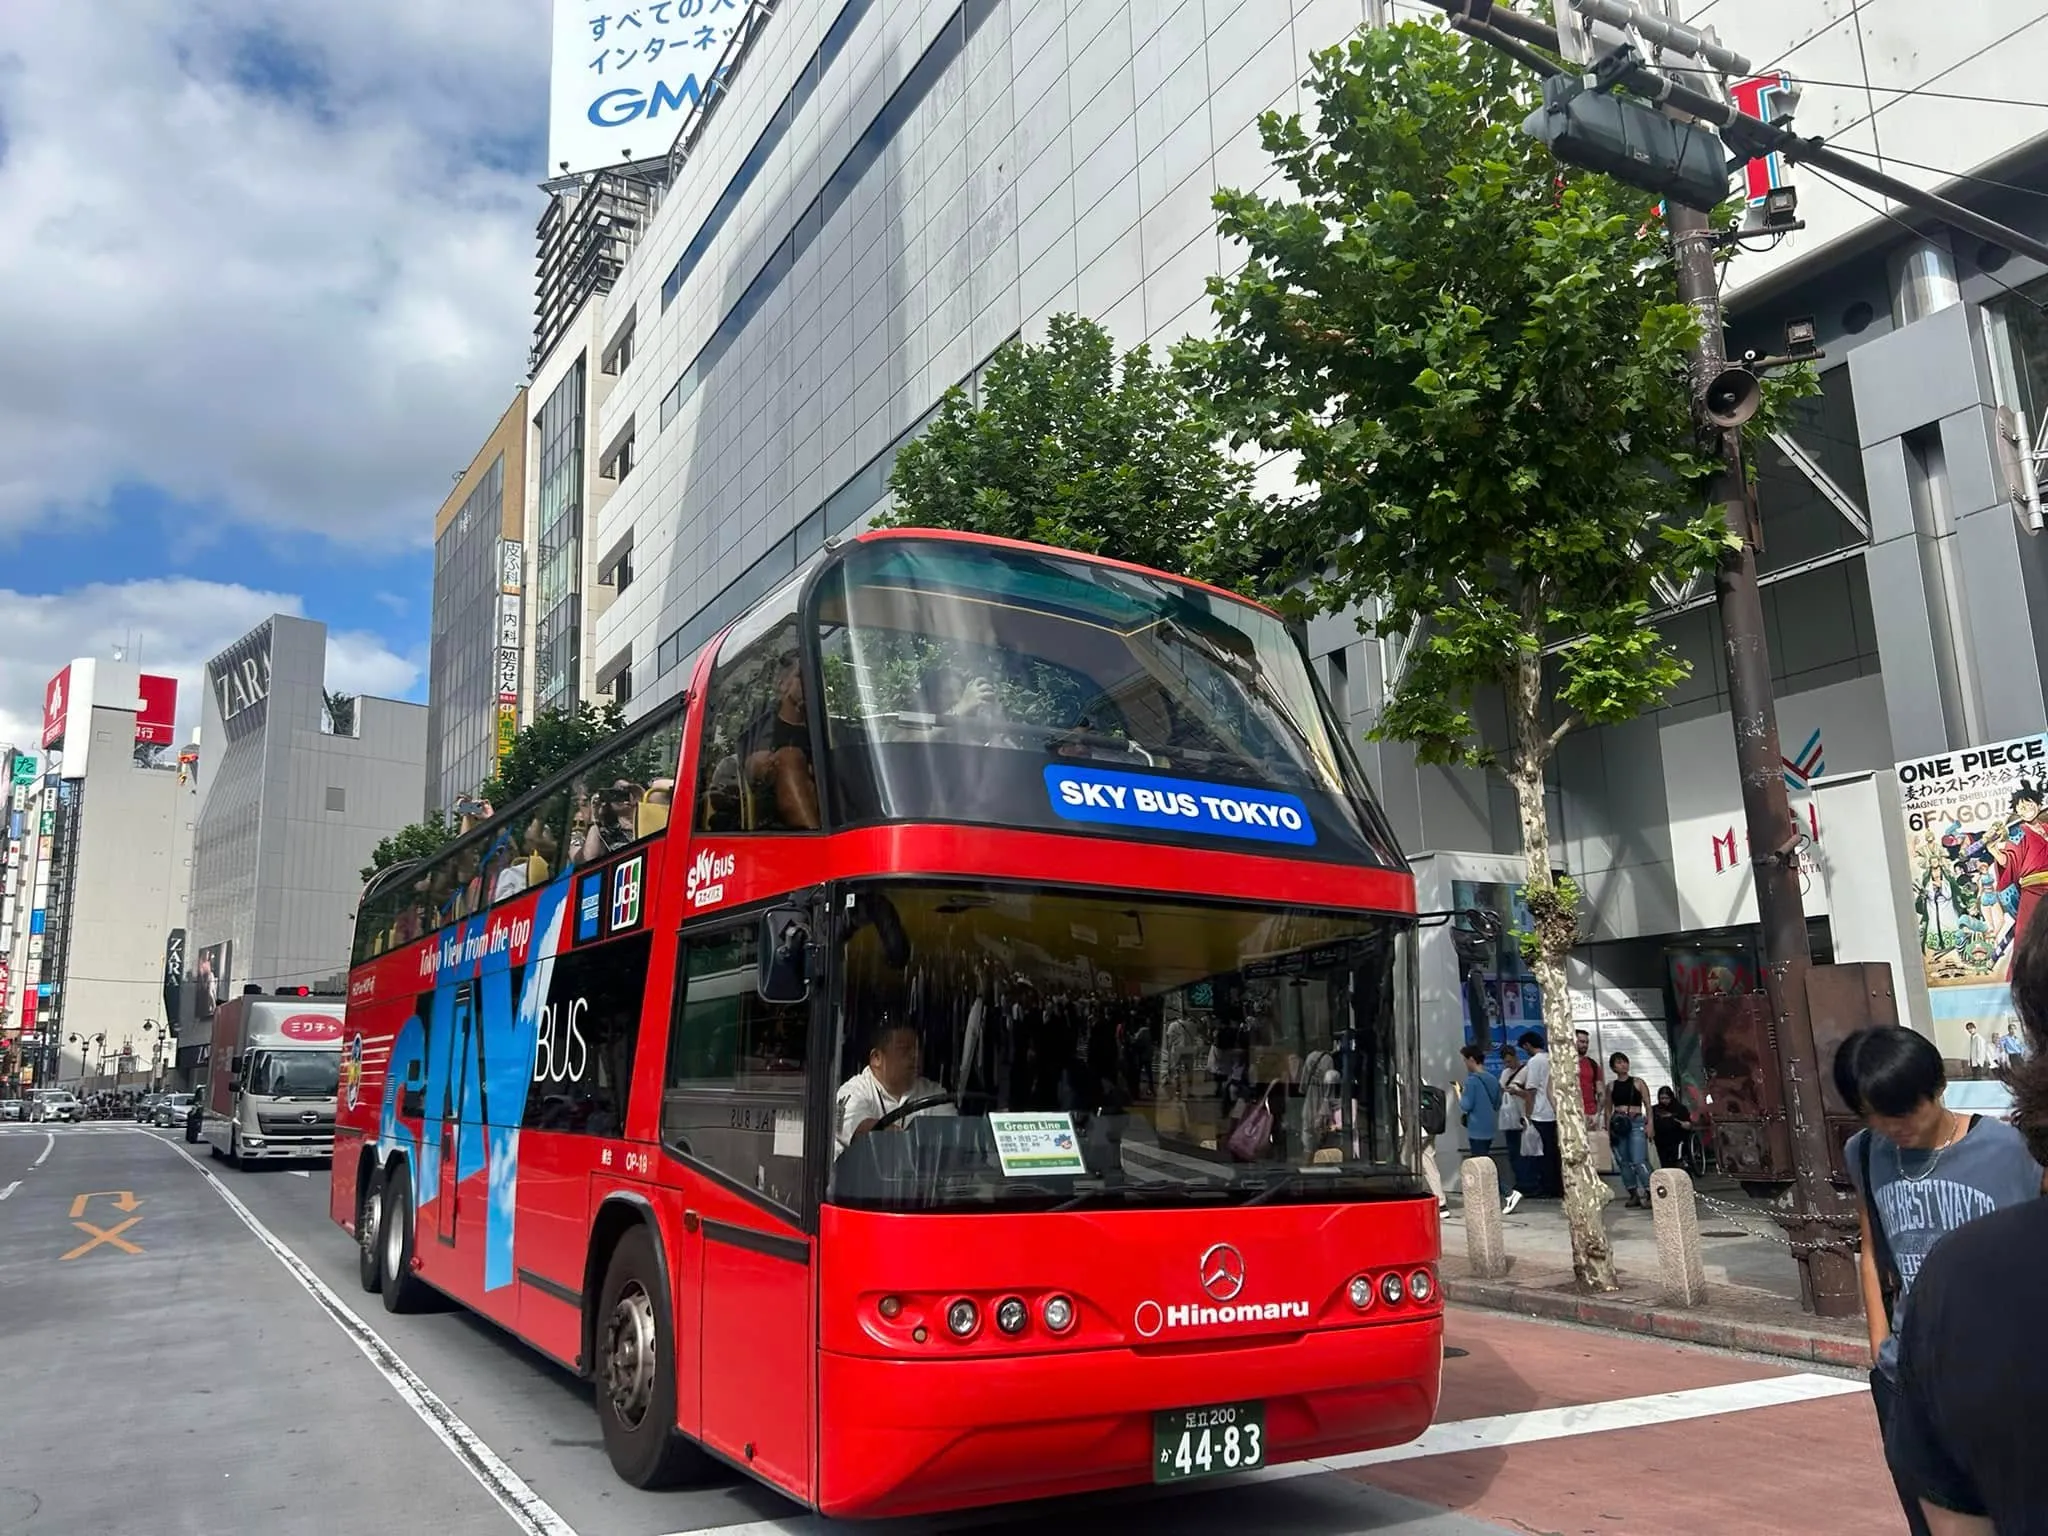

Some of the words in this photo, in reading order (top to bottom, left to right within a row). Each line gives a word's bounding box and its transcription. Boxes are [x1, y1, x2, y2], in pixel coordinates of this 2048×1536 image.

[504, 543, 521, 585] 皮ふ科
[503, 613, 517, 643] 内科
[501, 650, 516, 692] 処方せん
[1899, 757, 1954, 784] ONE
[1961, 739, 2045, 772] PIECE
[1059, 779, 1128, 811] SKY
[1132, 788, 1200, 818] BUS
[1201, 797, 1303, 832] TOKYO
[1906, 797, 1944, 811] MAGNET
[614, 881, 638, 907] JCB
[687, 847, 715, 900] SKY
[713, 853, 735, 879] BUS
[167, 937, 183, 987] ZARA
[419, 948, 442, 983] Tokyo
[443, 938, 467, 969] View
[464, 927, 489, 963] from
[490, 919, 509, 955] the
[509, 915, 531, 958] top
[533, 996, 588, 1083] BUS
[1004, 1121, 1036, 1131] Green
[1039, 1120, 1061, 1130] Line
[1895, 1178, 1936, 1232] BEST
[1932, 1179, 1973, 1231] WAY
[1167, 1300, 1310, 1328] Hinomaru
[1174, 1422, 1261, 1475] 44-83
